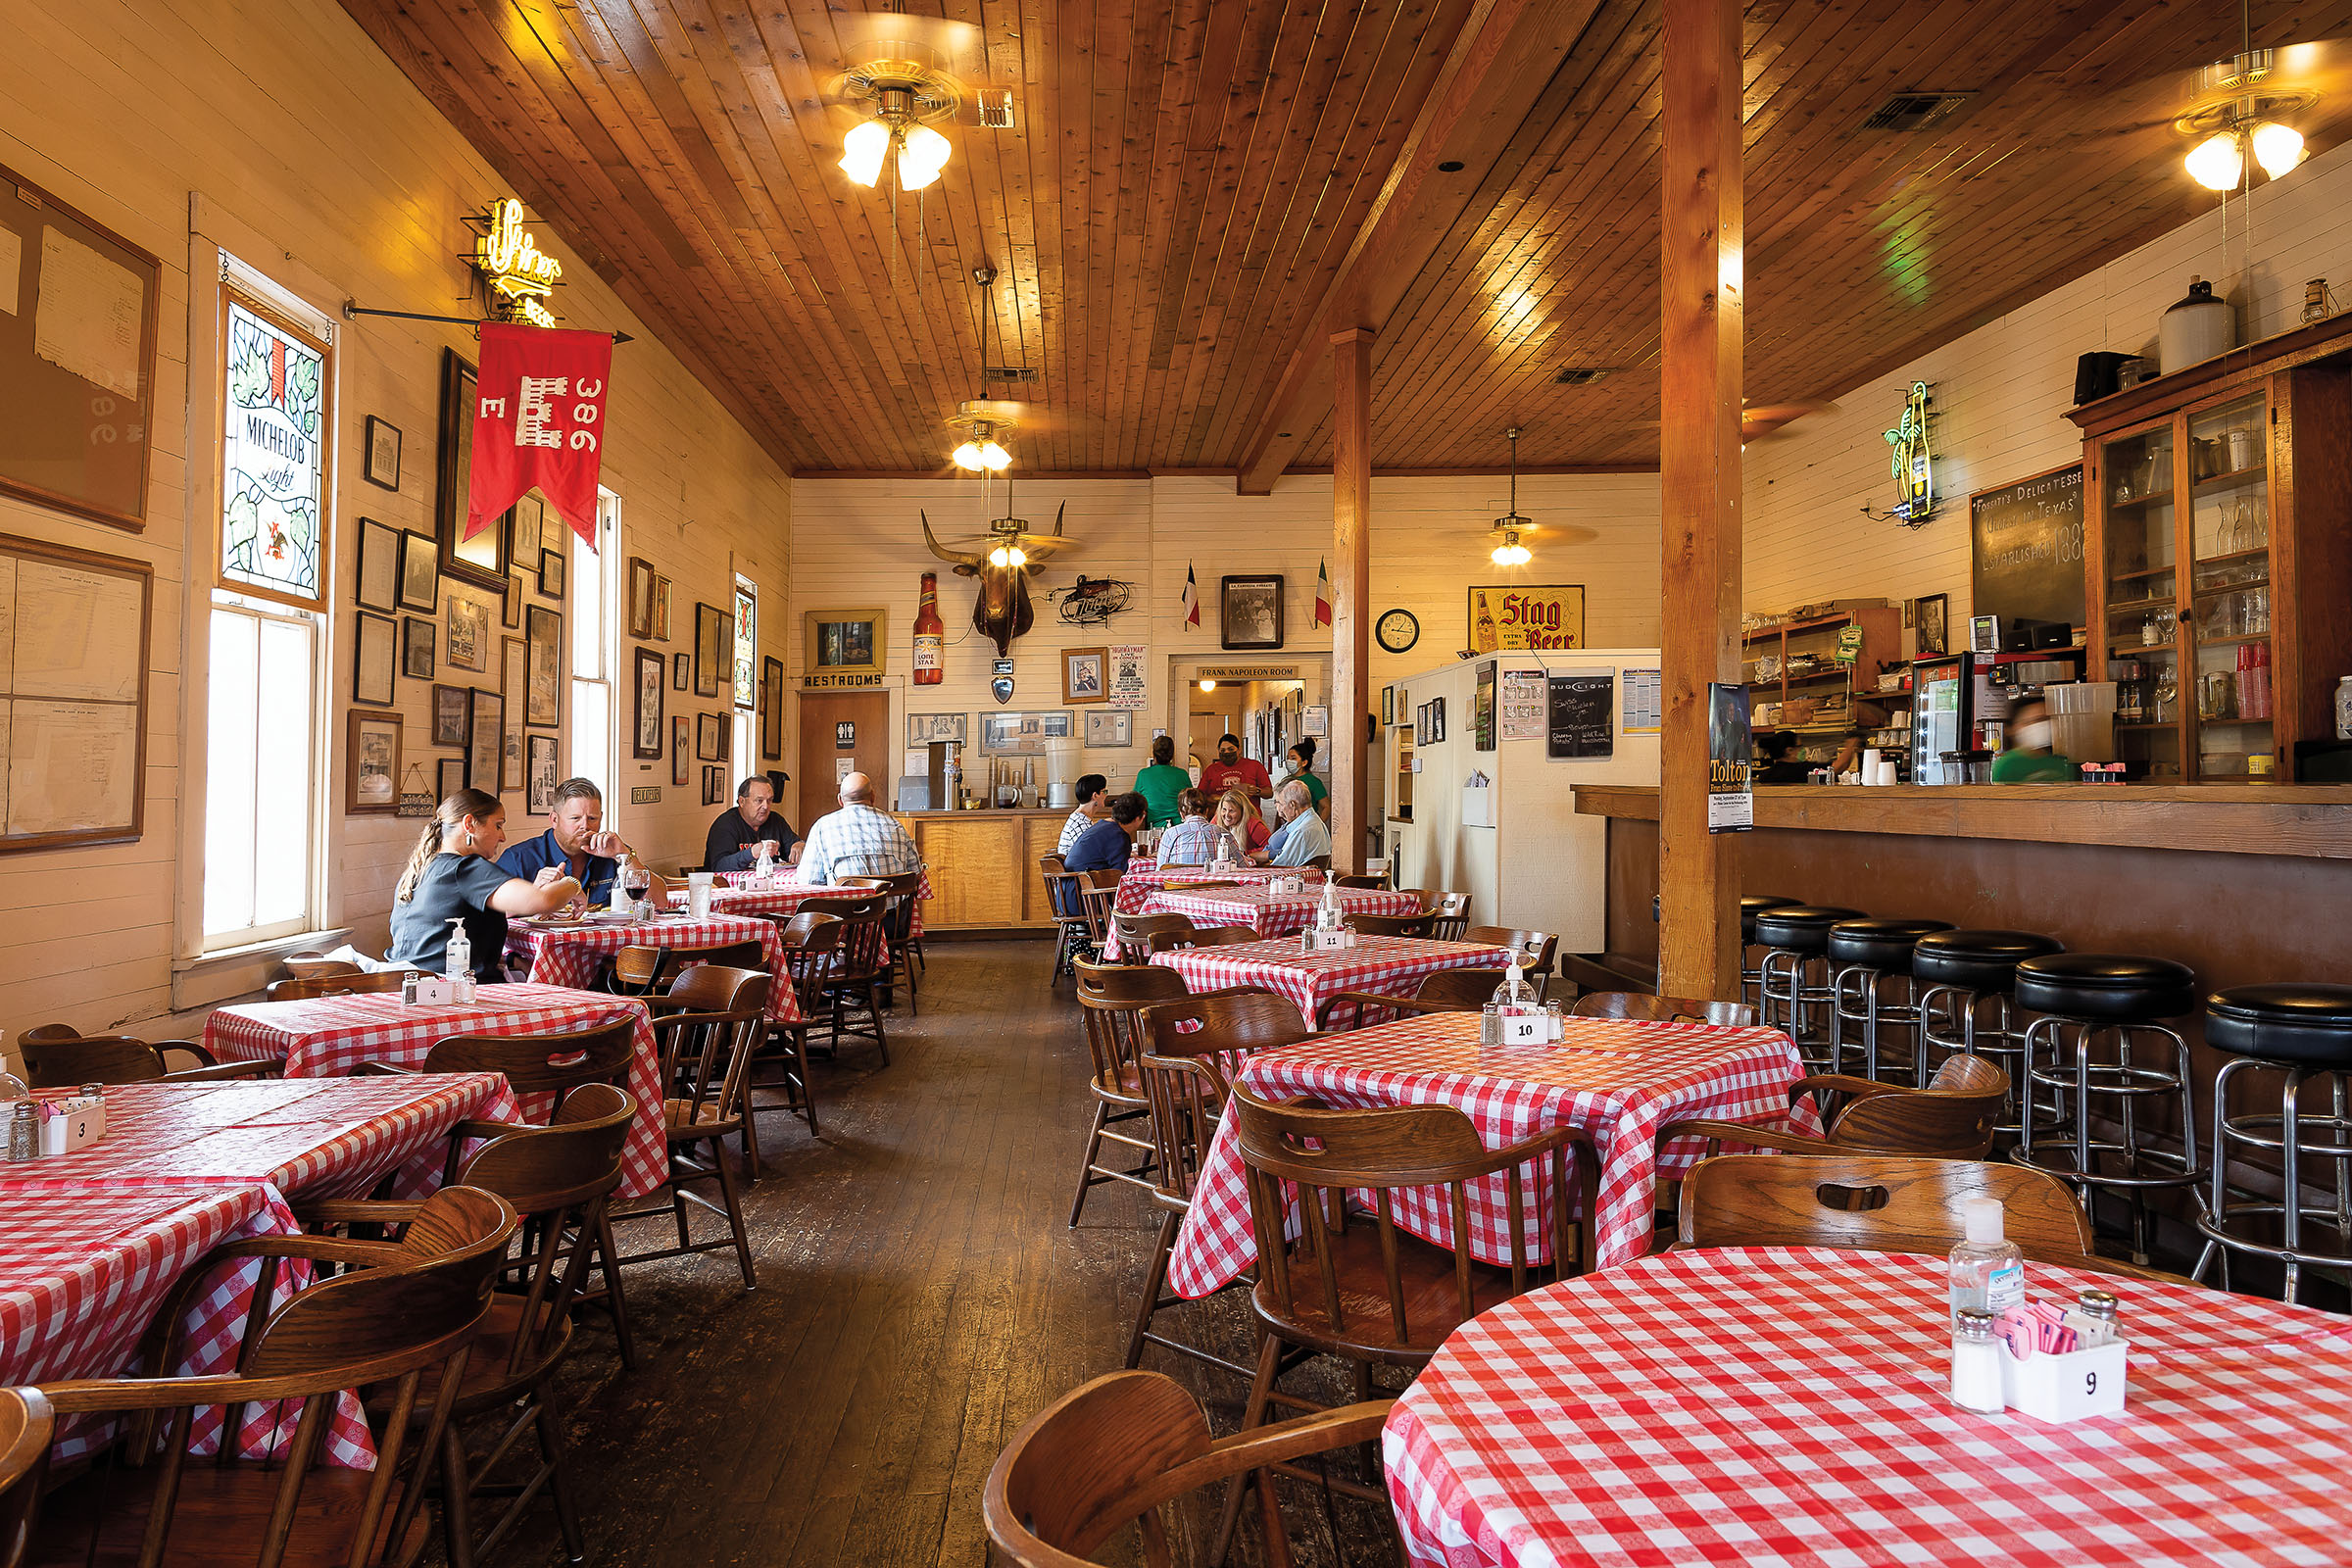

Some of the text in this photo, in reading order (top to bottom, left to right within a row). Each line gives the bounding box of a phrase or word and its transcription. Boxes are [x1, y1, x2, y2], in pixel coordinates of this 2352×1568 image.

[480, 397, 506, 418] E
[569, 377, 603, 454] 386
[246, 414, 305, 465] MICHELOB
[259, 463, 295, 492] Light
[2055, 521, 2085, 565] 188
[1499, 593, 1561, 632] Stag
[1523, 628, 1575, 650] Beer
[805, 674, 881, 687] RESTROOMS
[1710, 759, 1750, 782] Tolton
[1710, 784, 1722, 793] From
[1327, 937, 1337, 946] 11
[430, 989, 437, 999] 4
[1518, 1024, 1533, 1037] 10
[78, 1122, 85, 1138] 3
[2085, 1371, 2097, 1396] 9
